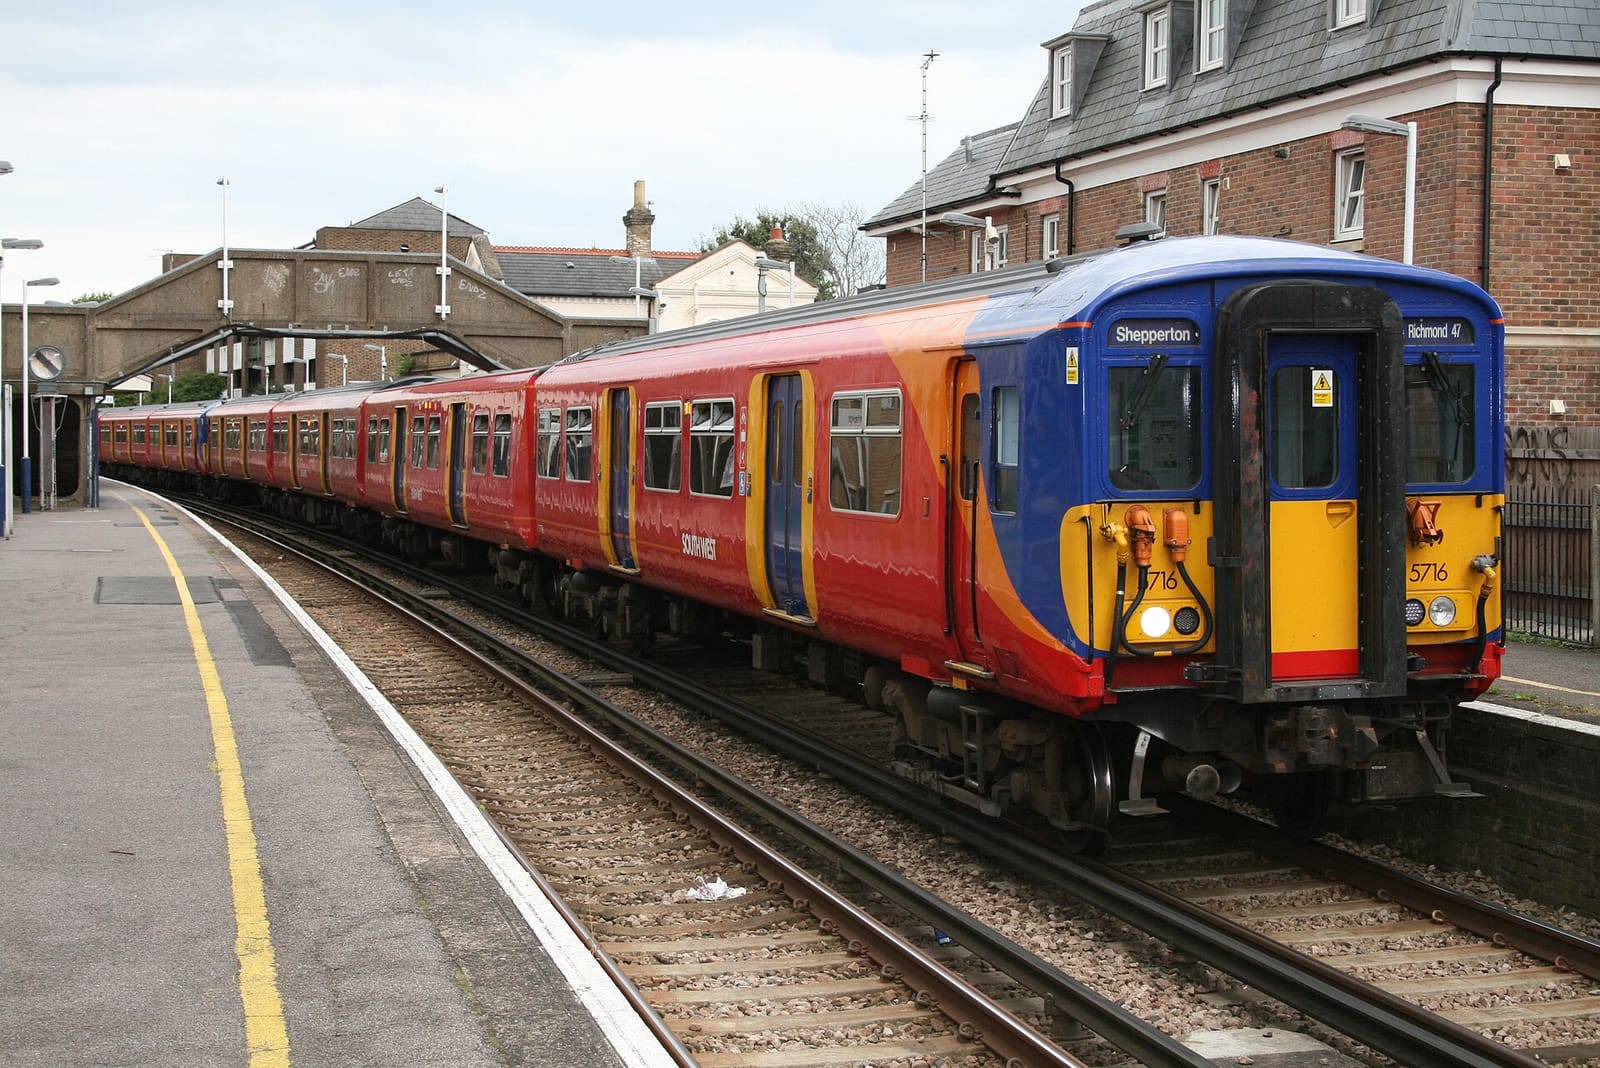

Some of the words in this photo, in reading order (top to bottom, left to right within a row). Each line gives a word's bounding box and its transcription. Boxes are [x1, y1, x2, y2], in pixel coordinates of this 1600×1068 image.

[1116, 326, 1191, 345] Shepperton
[1408, 322, 1448, 339] Richmond
[1451, 323, 1462, 338] 47
[682, 532, 701, 558] SOUTH
[699, 536, 717, 561] WEST
[1139, 570, 1178, 591] 716
[1408, 562, 1448, 583] 5716
